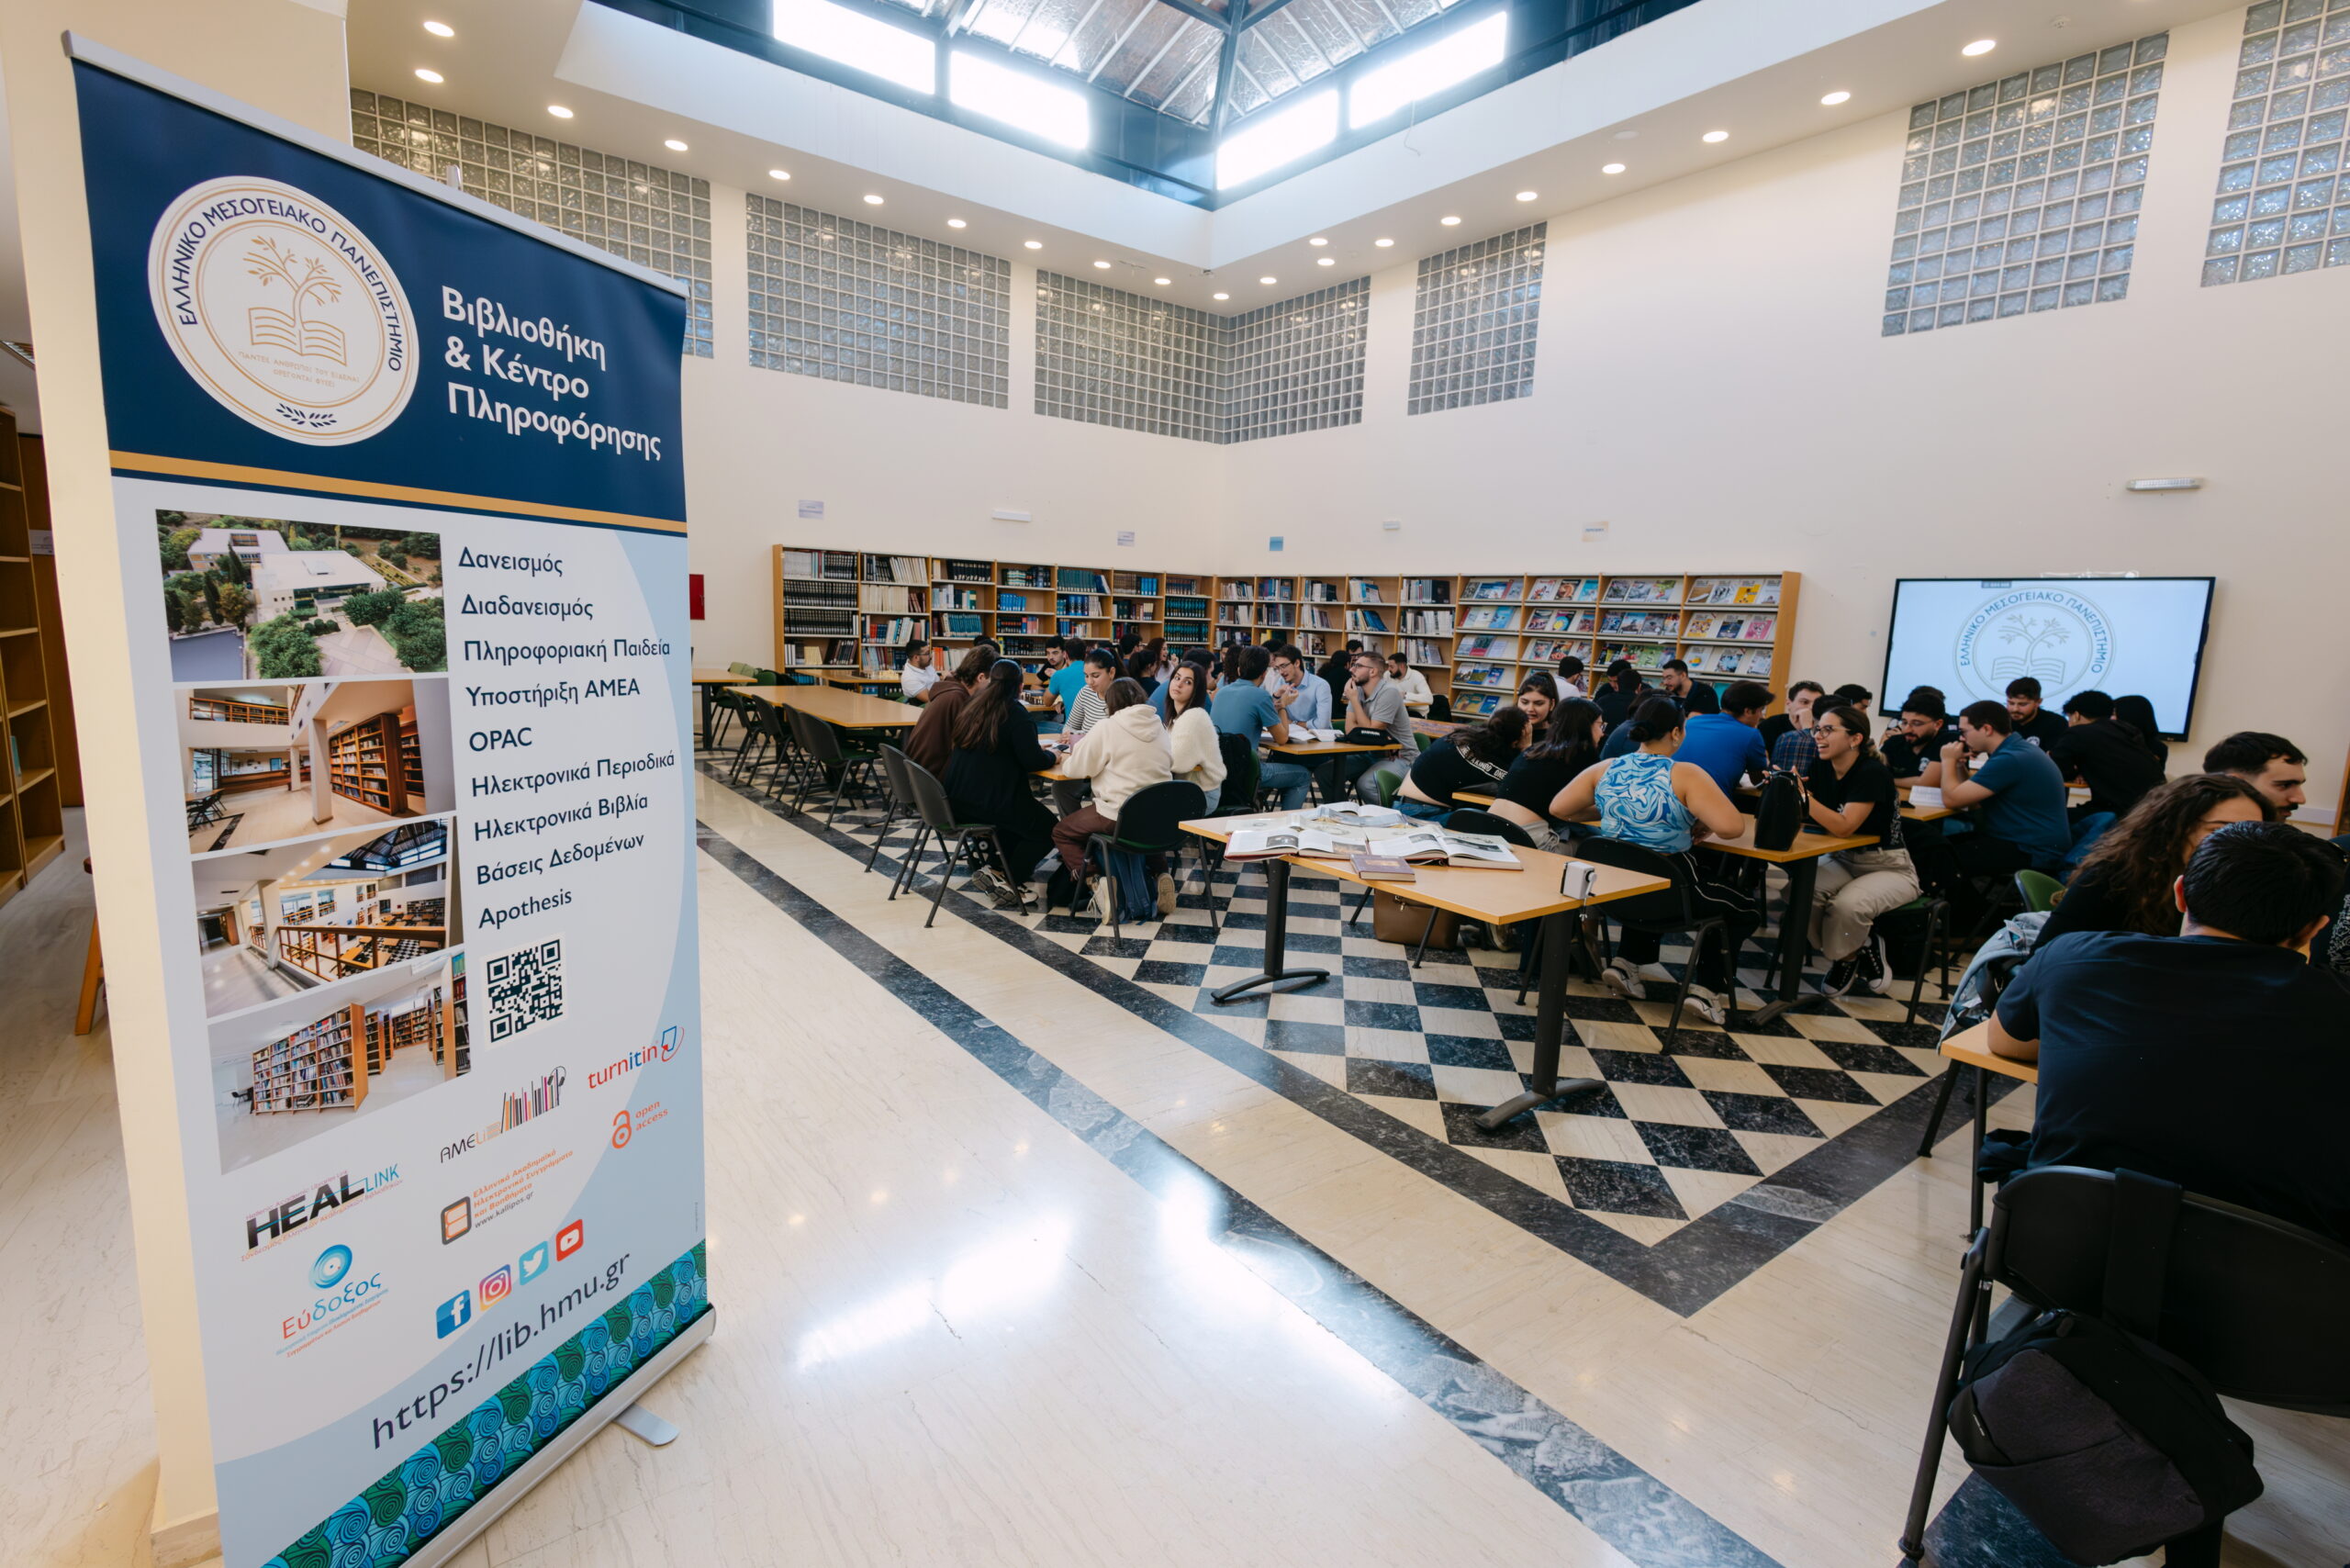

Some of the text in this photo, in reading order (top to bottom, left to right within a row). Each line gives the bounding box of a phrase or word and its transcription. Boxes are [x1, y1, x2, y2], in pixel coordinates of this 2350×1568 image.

[173, 197, 401, 372] ΕΛΛΗΝΙΚΟ ΜΕΣΟΓΕΙΑΚΟ ΠΑΝΕΠΙΣΤΗΜΙΟ
[442, 285, 606, 372] Βιβλιοθήκη
[444, 335, 589, 401] & Κέντρο
[448, 381, 661, 461] Πληροφόρησης
[458, 546, 563, 577] Δανεισμός
[461, 593, 593, 622] Διαδανεισμός
[464, 638, 670, 666] Πληροφοριακή Παιδεία
[1960, 590, 2109, 674] ΕΛΛΗΝΙΚΟ ΜΕΣΟΓΕΙΑΚΟ ΠΑΝΕΠΙΣΤΗΜΙΟ
[465, 678, 641, 708] Υποστήριξη ΑΜΕΑ
[469, 727, 532, 752] OPAC
[472, 750, 675, 797] Ηλεκτρονικά Περιοδικά
[475, 793, 648, 841] Ηλεκτρονικά Βιβλία
[476, 834, 644, 885] Βάσεις Δεδομένων
[478, 889, 572, 929] Apothesis
[588, 1043, 658, 1089] turnitin
[635, 1102, 660, 1120] open
[635, 1109, 668, 1131] access
[475, 1191, 534, 1228] www.kallipos.gr
[282, 1272, 382, 1339] Εύδοξος
[373, 1253, 630, 1449] https://lib.hmu.gr
